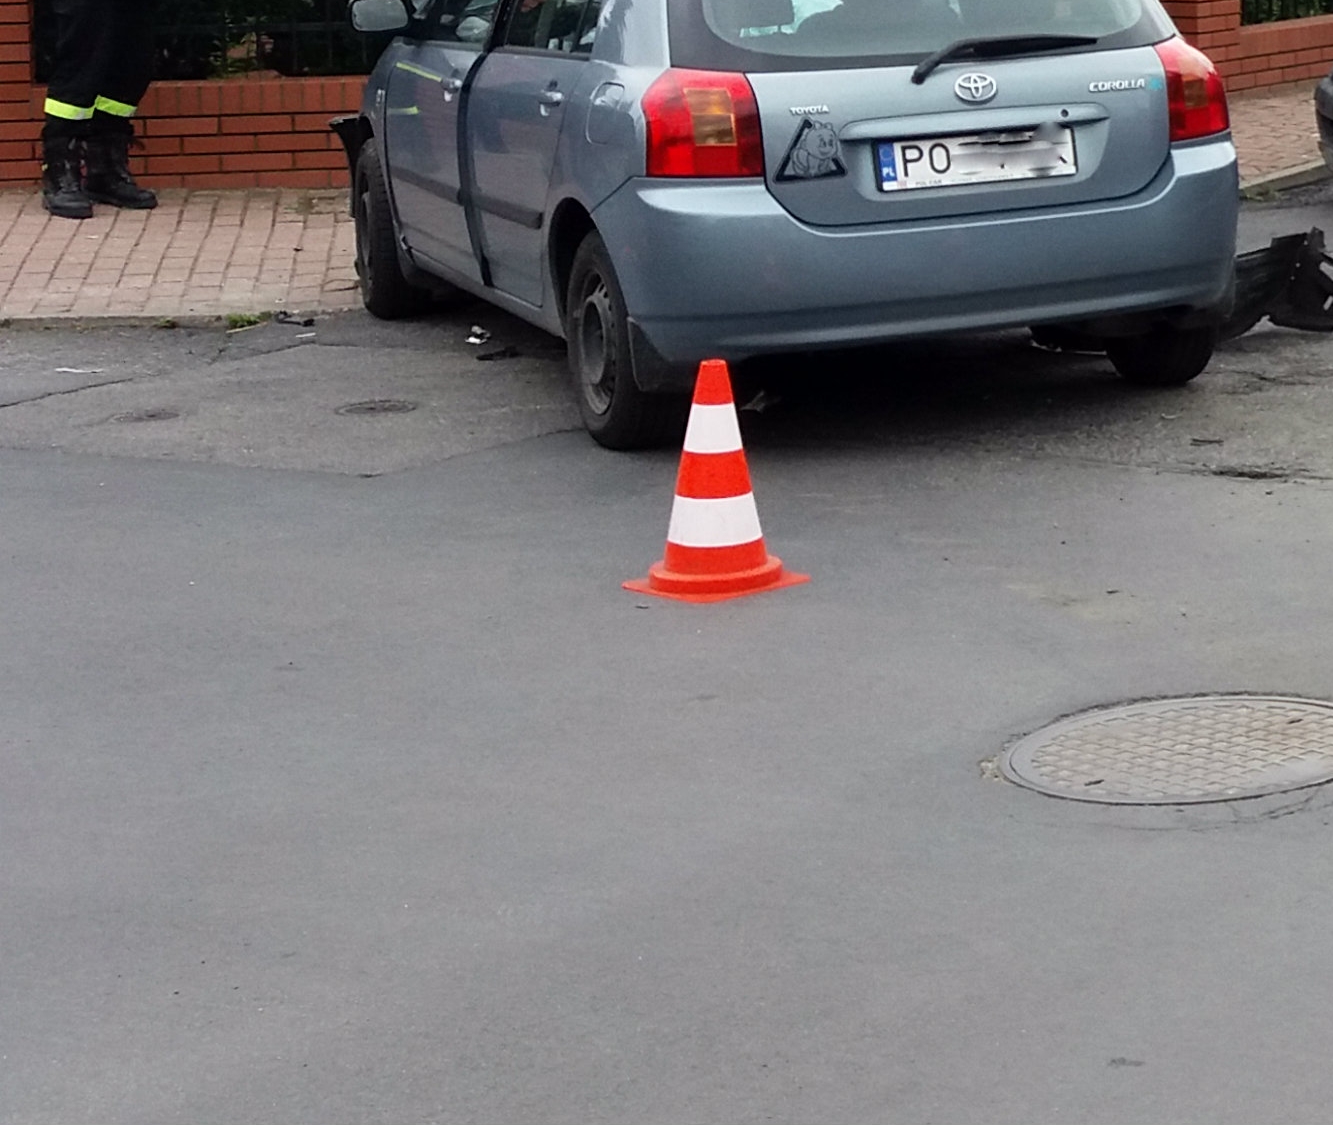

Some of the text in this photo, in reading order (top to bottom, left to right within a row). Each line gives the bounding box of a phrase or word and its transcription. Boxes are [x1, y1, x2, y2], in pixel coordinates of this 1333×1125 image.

[1089, 78, 1145, 92] COROLLA
[790, 105, 830, 115] TOYOTA
[882, 167, 895, 177] PL
